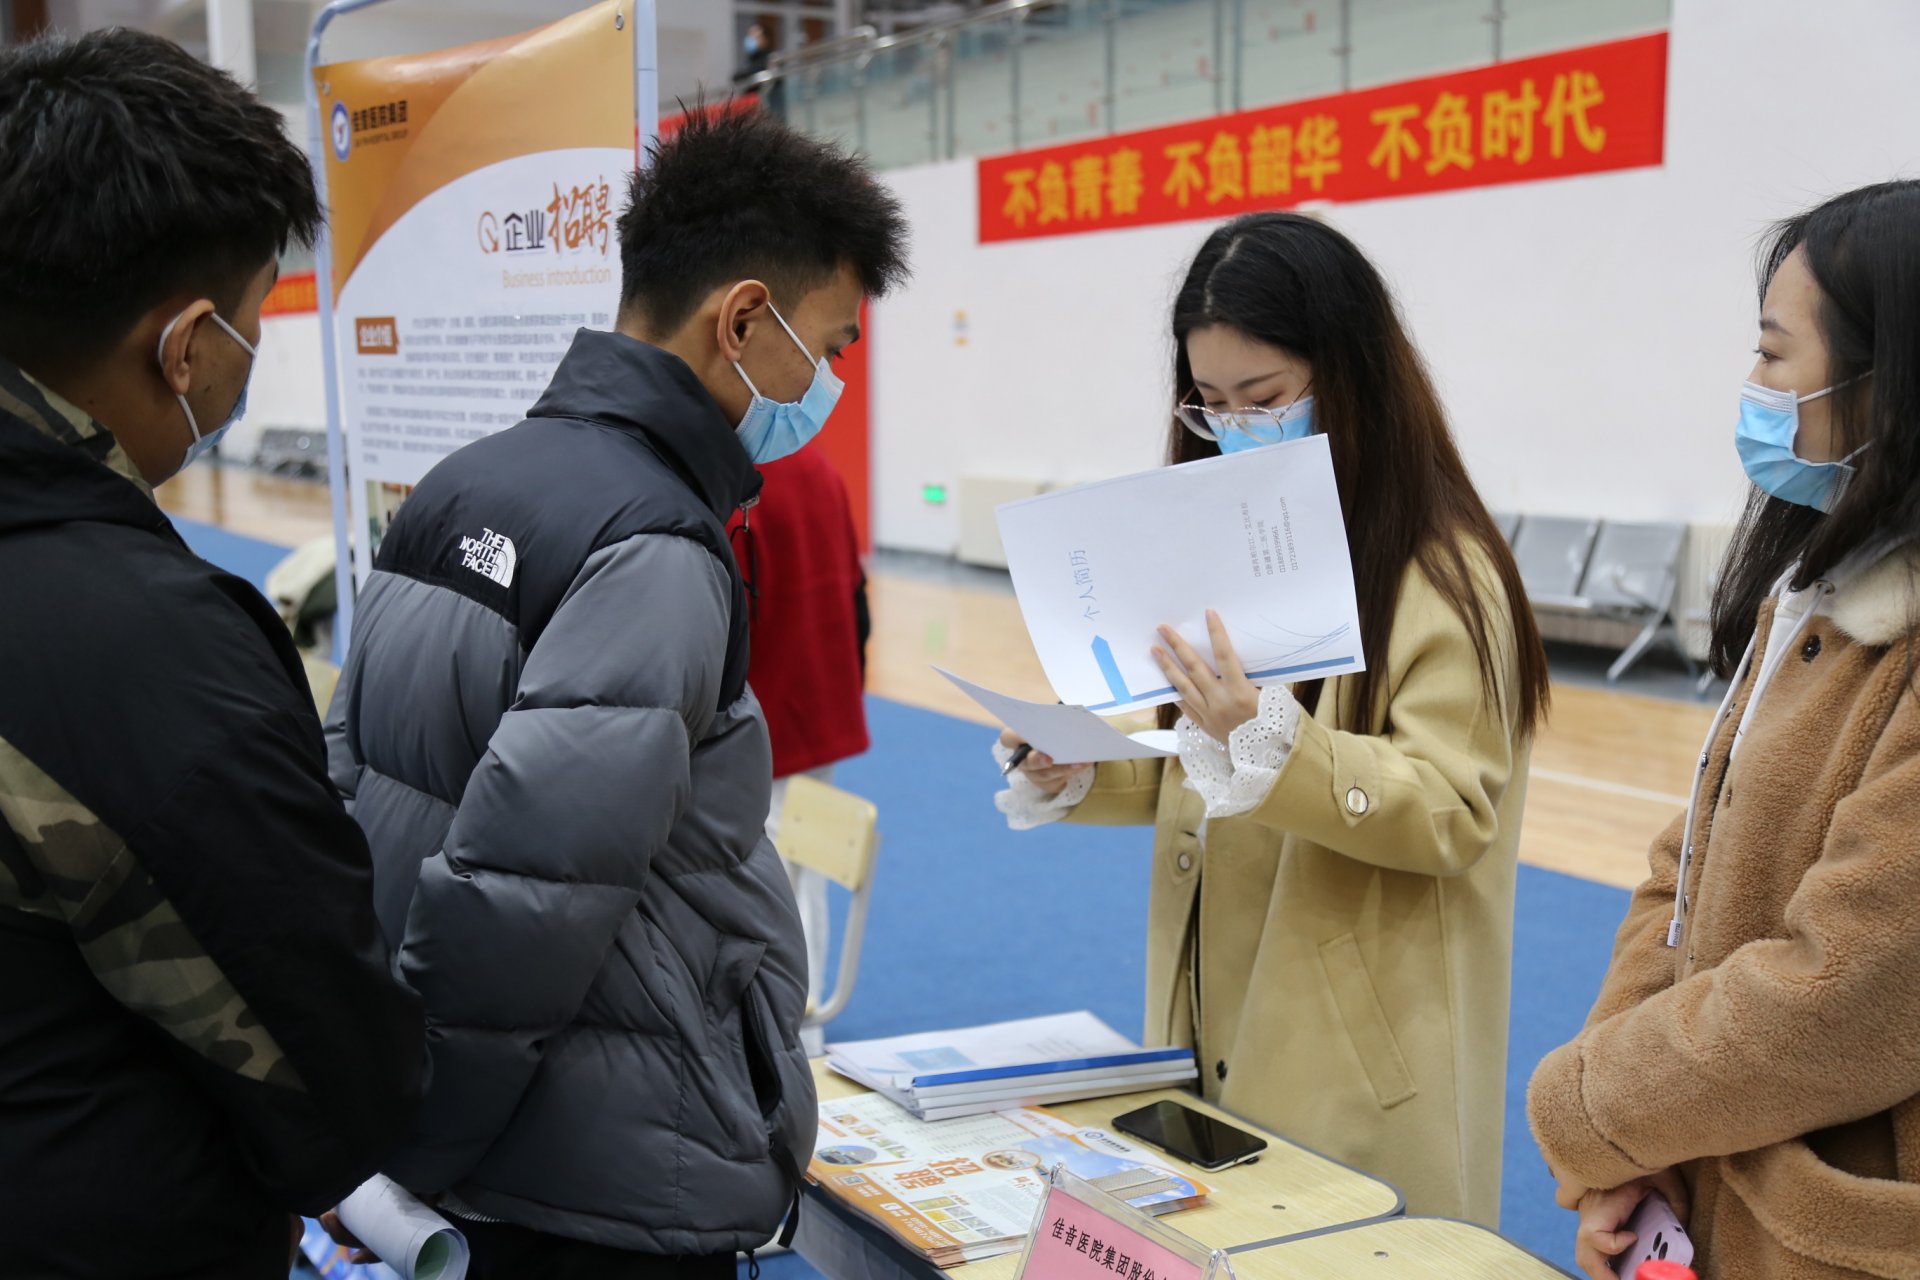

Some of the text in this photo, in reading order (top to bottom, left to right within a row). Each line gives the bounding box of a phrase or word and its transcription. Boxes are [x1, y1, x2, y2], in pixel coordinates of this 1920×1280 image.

[1002, 69, 1606, 229] 不负青春 不负韶华 不负时代
[502, 266, 611, 288] Business introduction
[459, 536, 499, 565] NORTH
[481, 527, 506, 550] THE
[462, 552, 495, 577] FACE
[1068, 549, 1100, 621] 个人简历
[1051, 1217, 1169, 1280] 佳音医院集团股份
